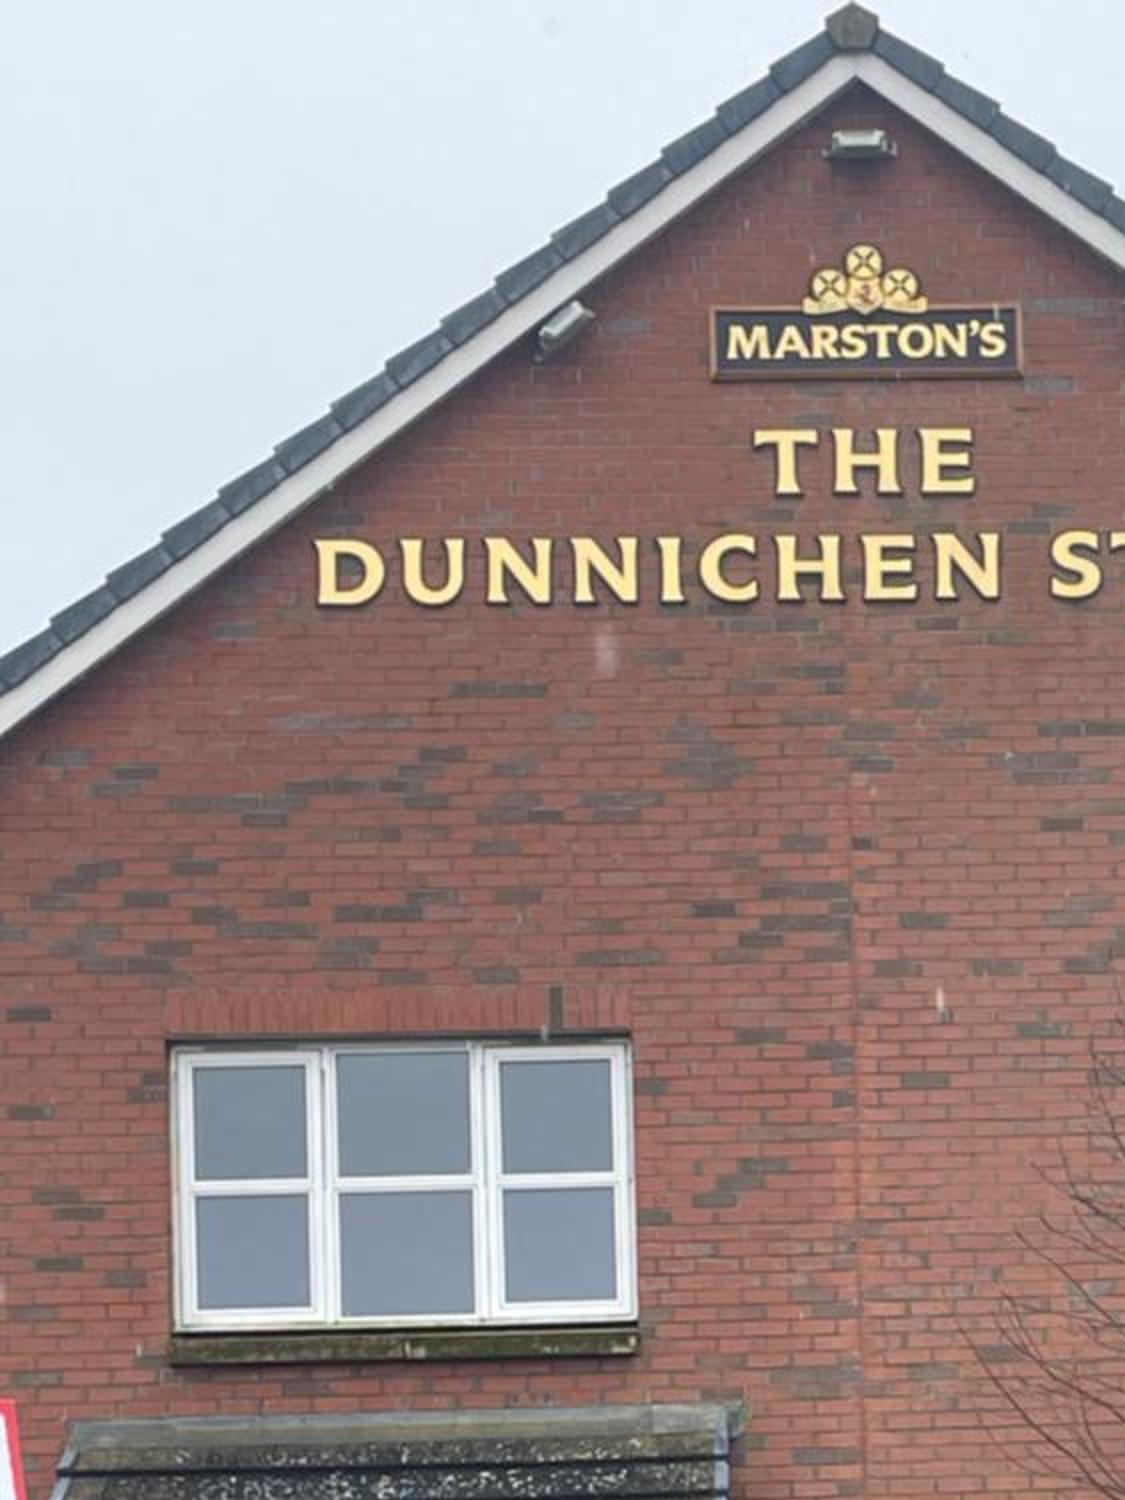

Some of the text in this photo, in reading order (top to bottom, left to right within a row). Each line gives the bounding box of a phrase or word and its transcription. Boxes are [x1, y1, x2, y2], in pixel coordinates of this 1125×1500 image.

[726, 319, 1007, 361] MARSTON'S
[754, 427, 977, 497] THE
[313, 532, 1003, 608] DUNNICHEN
